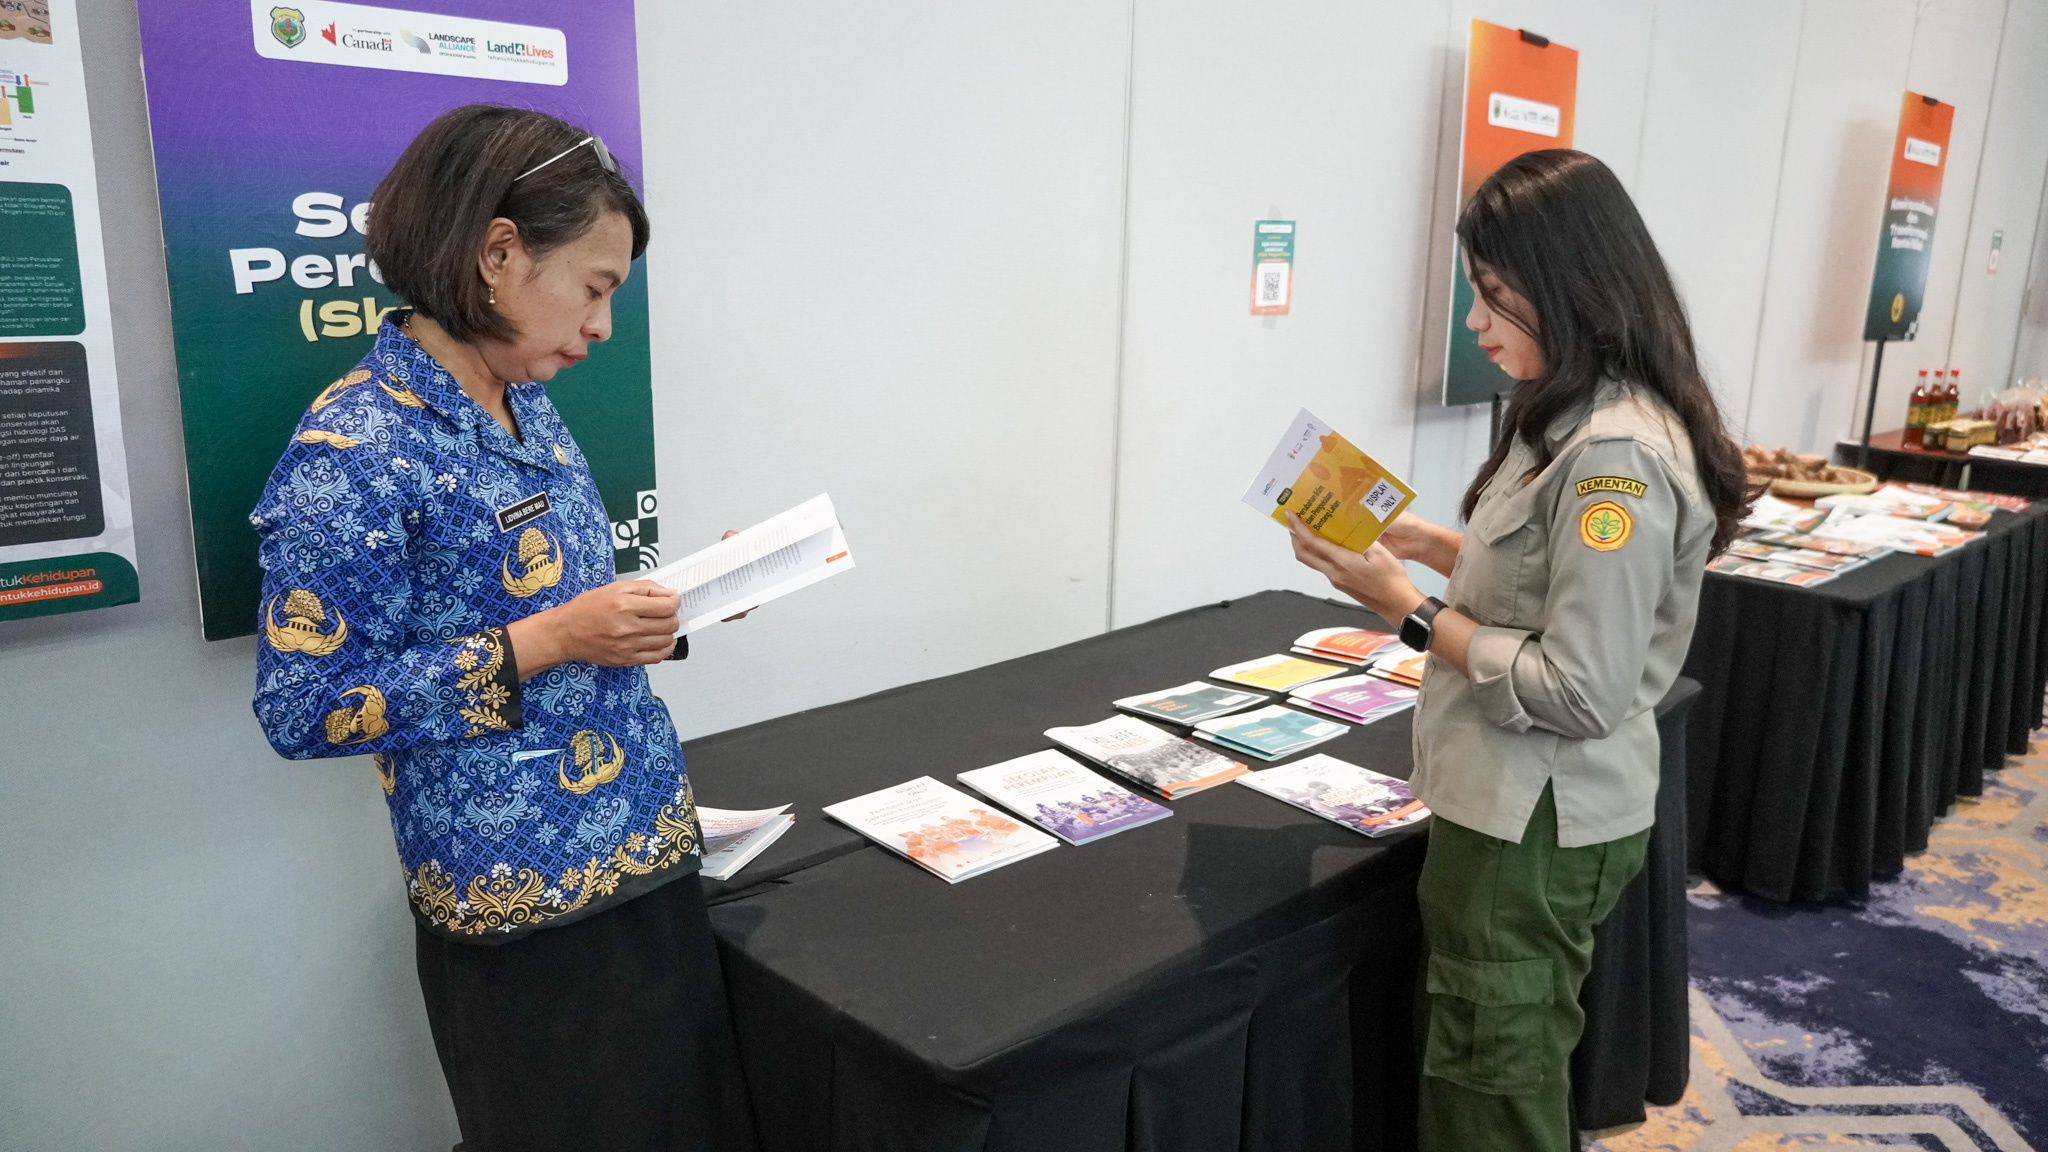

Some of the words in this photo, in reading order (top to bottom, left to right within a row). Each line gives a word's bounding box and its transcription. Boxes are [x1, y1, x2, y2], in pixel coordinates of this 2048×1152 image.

[342, 33, 393, 52] Canada
[428, 32, 476, 45] LANDSCAPE
[439, 42, 476, 53] ALLIANCE
[292, 192, 374, 238] Se
[300, 297, 413, 342] (Sk
[21, 369, 46, 377] efektif
[29, 378, 70, 386] pemangku
[25, 386, 60, 394] dinamika
[28, 410, 69, 418] keputusan
[0, 420, 39, 428] onservasi
[14, 428, 48, 436] hidrologi
[0, 438, 16, 446] gan
[50, 435, 69, 443] daya
[11, 460, 54, 469] lingkungan
[22, 468, 55, 476] bencana
[18, 478, 45, 486] praktik
[1579, 479, 1642, 494] KEMENTAN
[4, 493, 35, 501] memicu
[37, 490, 78, 499] munculnya
[1366, 482, 1388, 506] DISPLAY
[15, 500, 63, 509] kepentingan
[1380, 495, 1398, 512] ONLY
[20, 508, 64, 517] masyarakat
[15, 516, 61, 526] memulihkan
[63, 513, 86, 522] fungsi
[0, 568, 96, 588] tukKehidupan
[1002, 765, 1059, 784] SEKOLAH
[1003, 769, 1076, 791] PEREMPUAN
